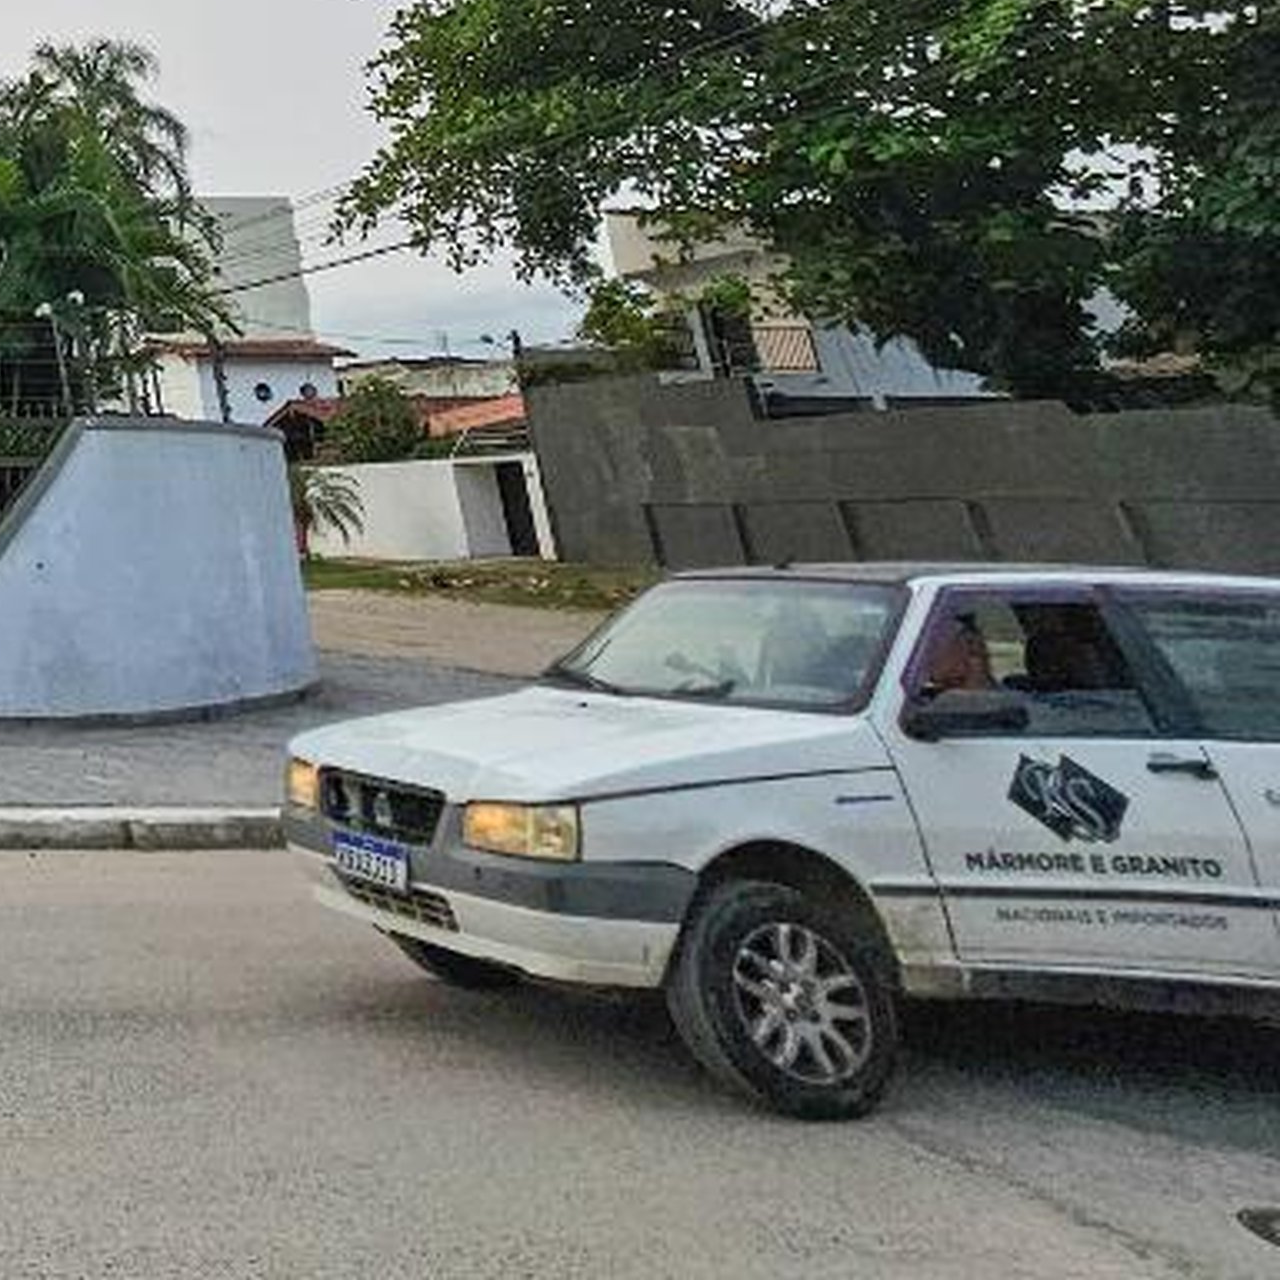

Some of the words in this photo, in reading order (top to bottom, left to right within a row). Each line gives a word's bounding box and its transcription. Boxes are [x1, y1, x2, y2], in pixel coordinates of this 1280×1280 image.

[965, 847, 1085, 872] MÁRMORE
[1090, 854, 1107, 874] E
[1112, 855, 1222, 878] GRANITO
